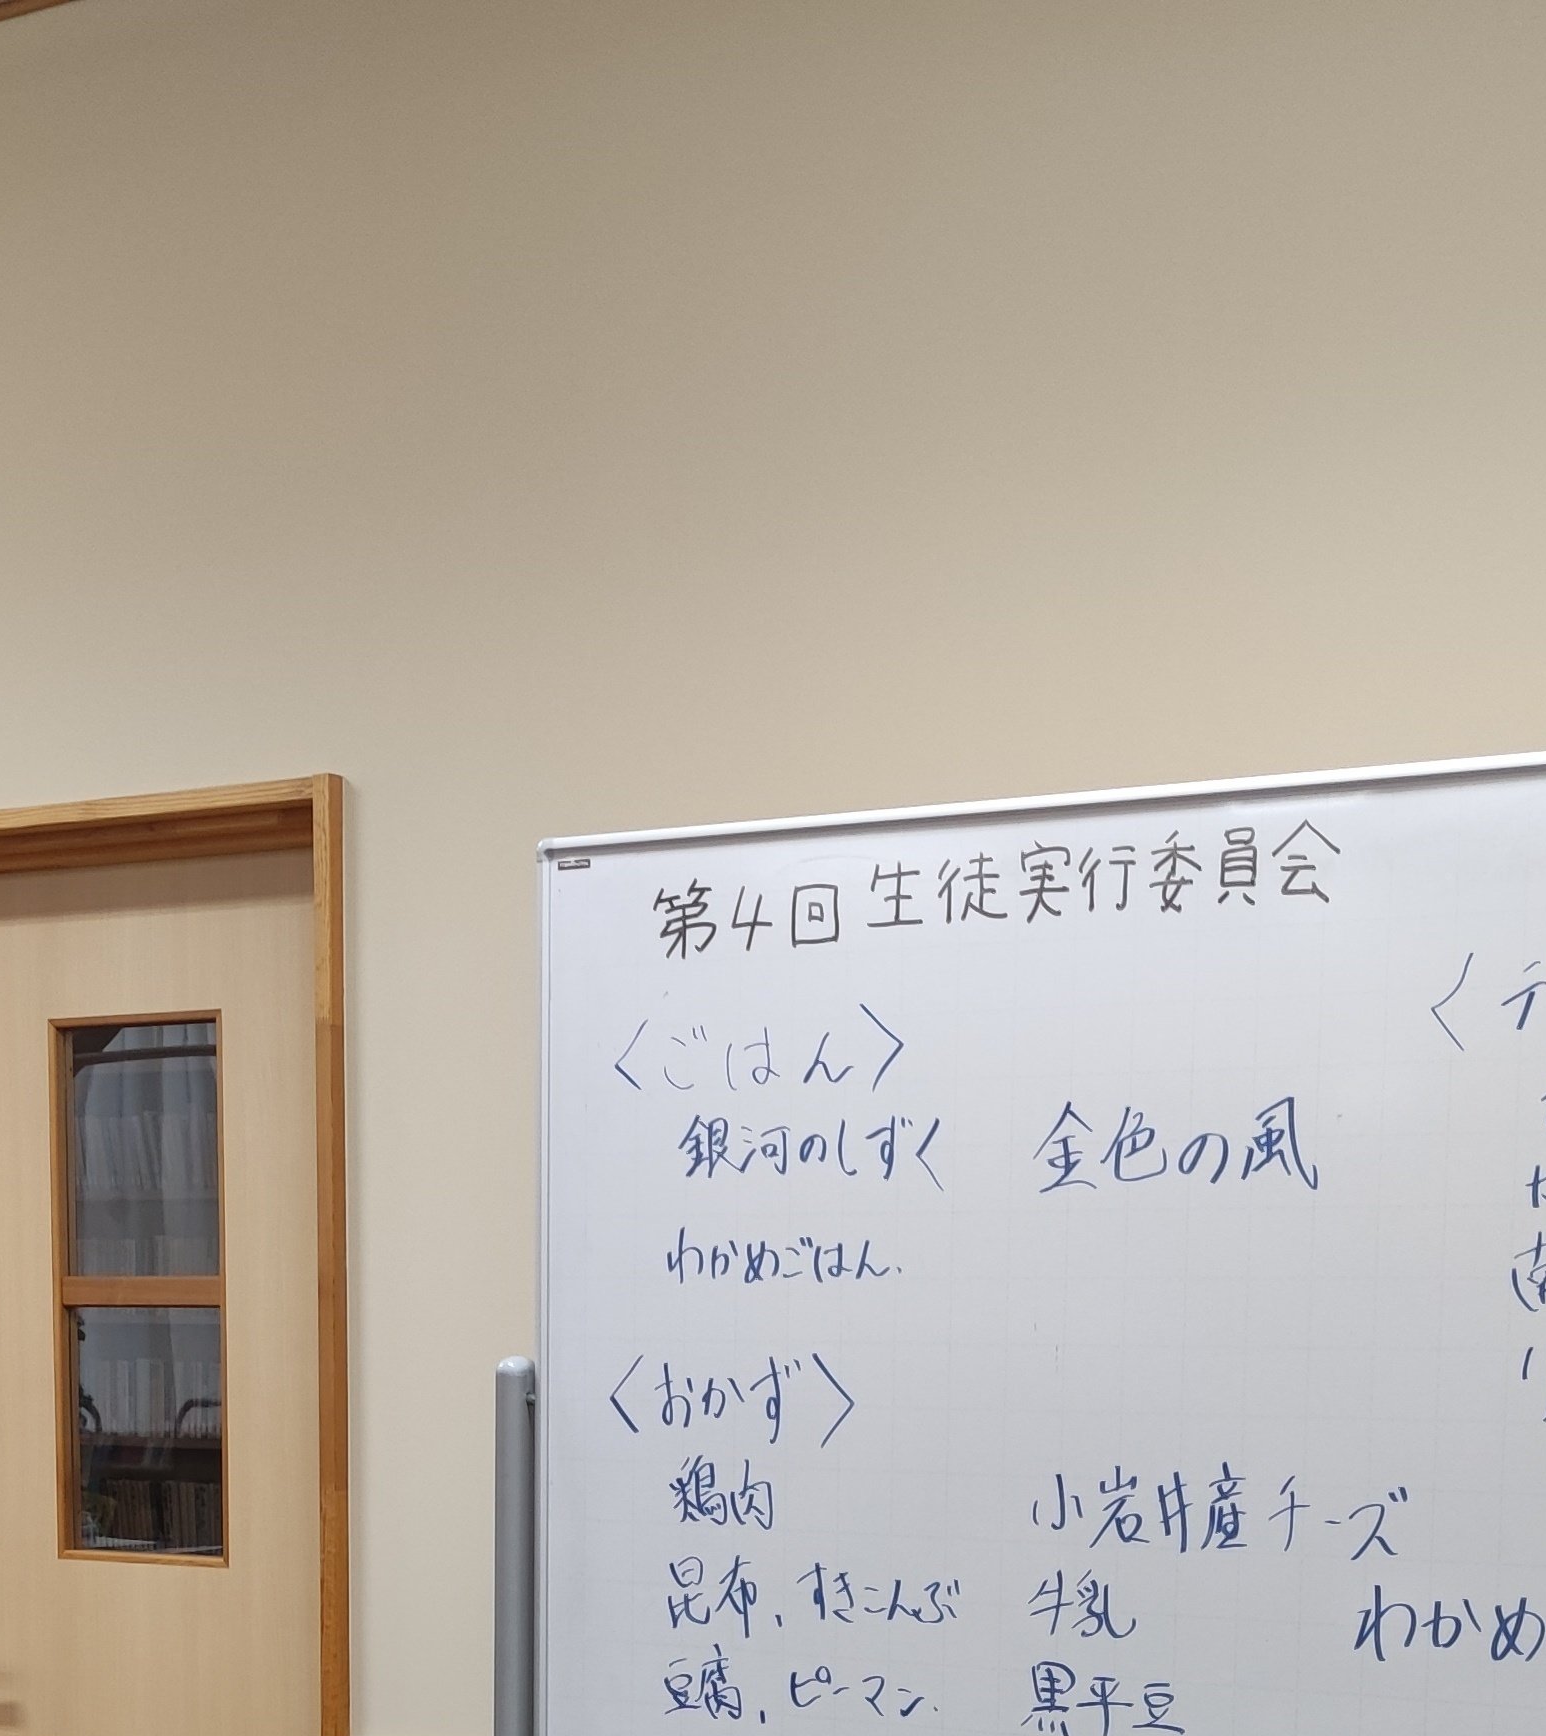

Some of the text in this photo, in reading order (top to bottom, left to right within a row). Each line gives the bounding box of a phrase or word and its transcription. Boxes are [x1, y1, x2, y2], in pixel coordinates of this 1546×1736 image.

[653, 818, 1342, 960] 第4回 生徒実行委員会
[676, 1113, 946, 1193] 銀河のしずく
[1033, 1096, 1320, 1194] 金色の風
[668, 1455, 777, 1529] 鶏肉
[1031, 1461, 1409, 1562] 小岩井産チーズ
[1026, 1570, 1138, 1641] 牛乳
[1353, 1583, 1546, 1662] わかめ
